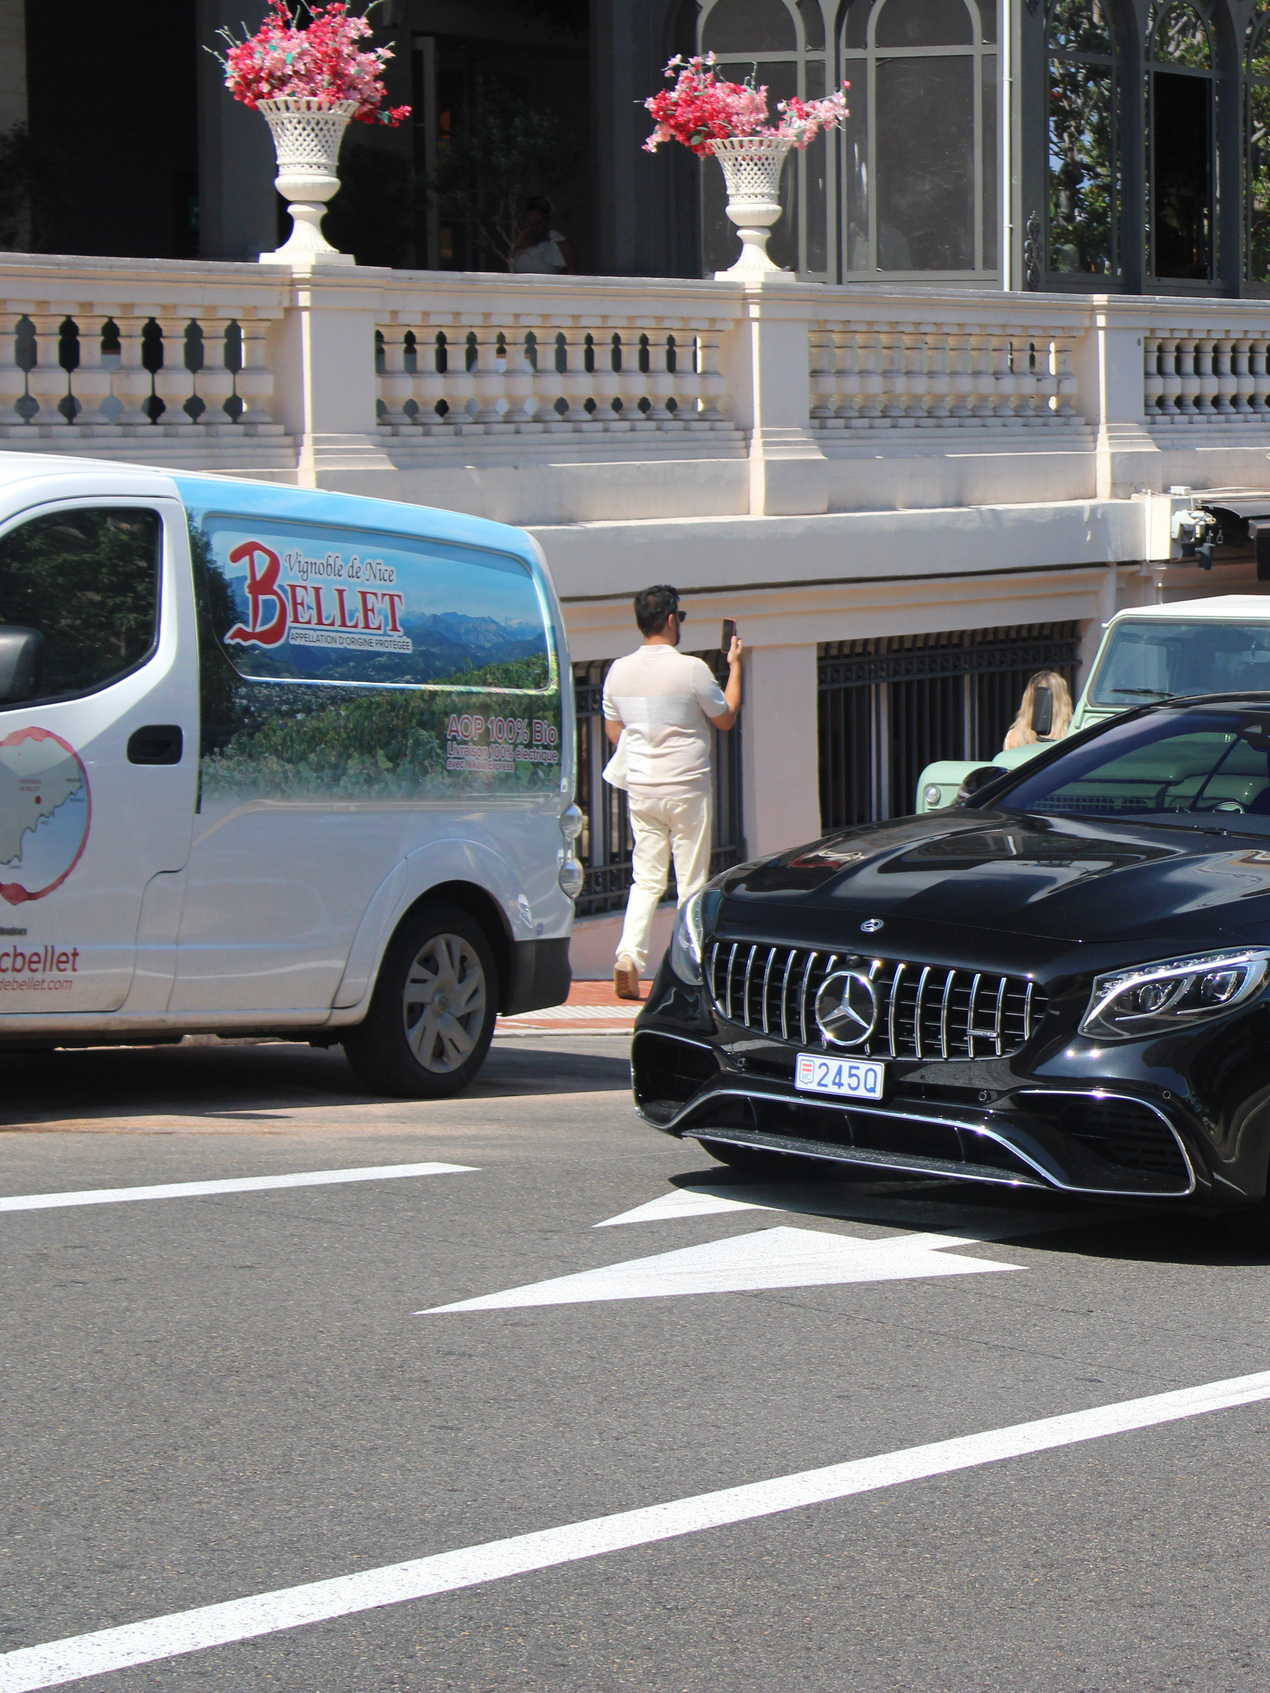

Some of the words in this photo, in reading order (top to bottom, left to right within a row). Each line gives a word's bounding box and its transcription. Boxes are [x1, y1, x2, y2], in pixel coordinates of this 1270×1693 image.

[285, 552, 343, 581] Vignoble
[347, 557, 361, 579] de
[365, 562, 394, 582] Nice
[228, 541, 403, 645] BELLET
[290, 632, 337, 644] APPELLATION
[339, 635, 374, 647] D'ORIGINE
[447, 714, 484, 740] AOP
[487, 717, 529, 743] 100%
[532, 719, 558, 745] Bio
[447, 741, 488, 758] Livraison
[489, 744, 514, 760] 100%
[447, 759, 464, 769] avec
[817, 1062, 878, 1093] 245Q
